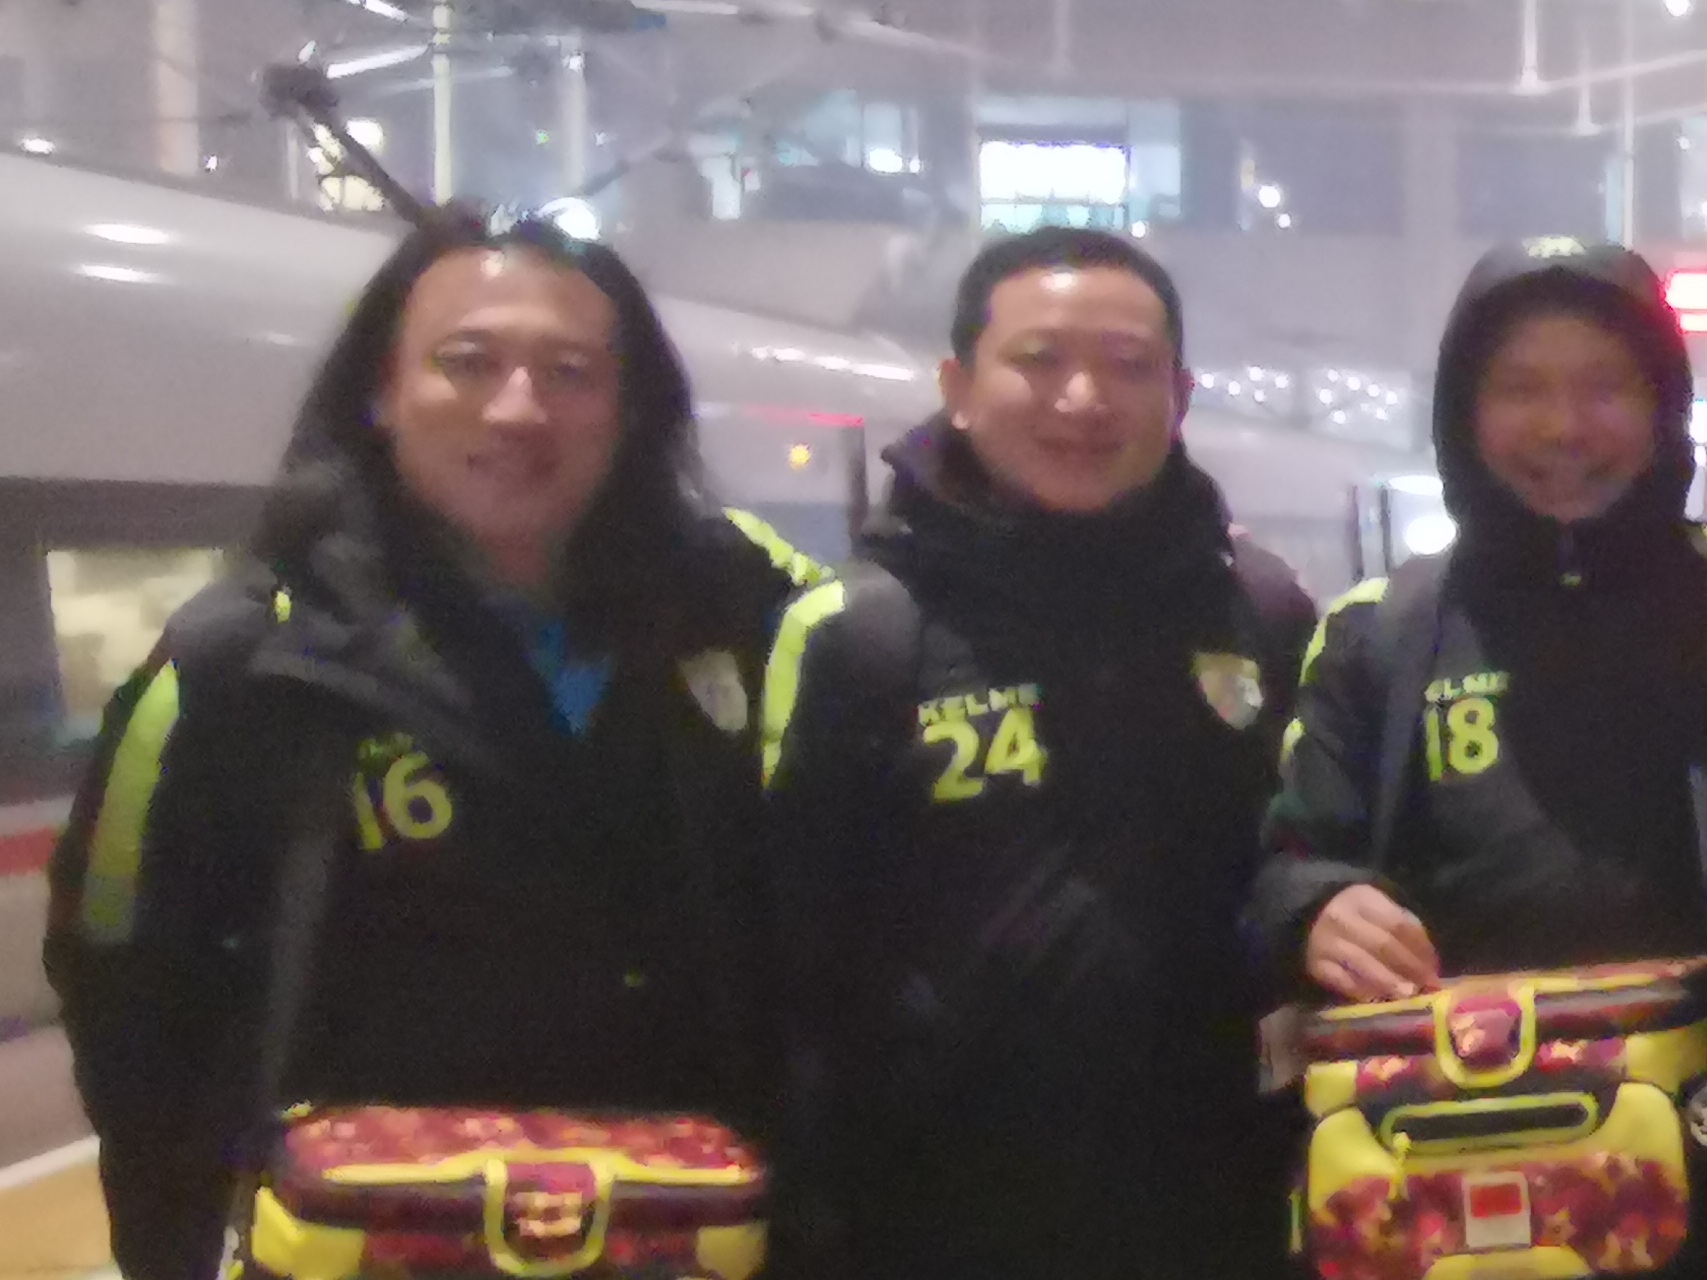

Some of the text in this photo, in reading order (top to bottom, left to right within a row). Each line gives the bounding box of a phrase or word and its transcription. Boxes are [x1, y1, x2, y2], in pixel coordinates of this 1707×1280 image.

[922, 706, 1048, 804] 24
[1425, 696, 1500, 782] 18
[353, 750, 453, 850] 16
